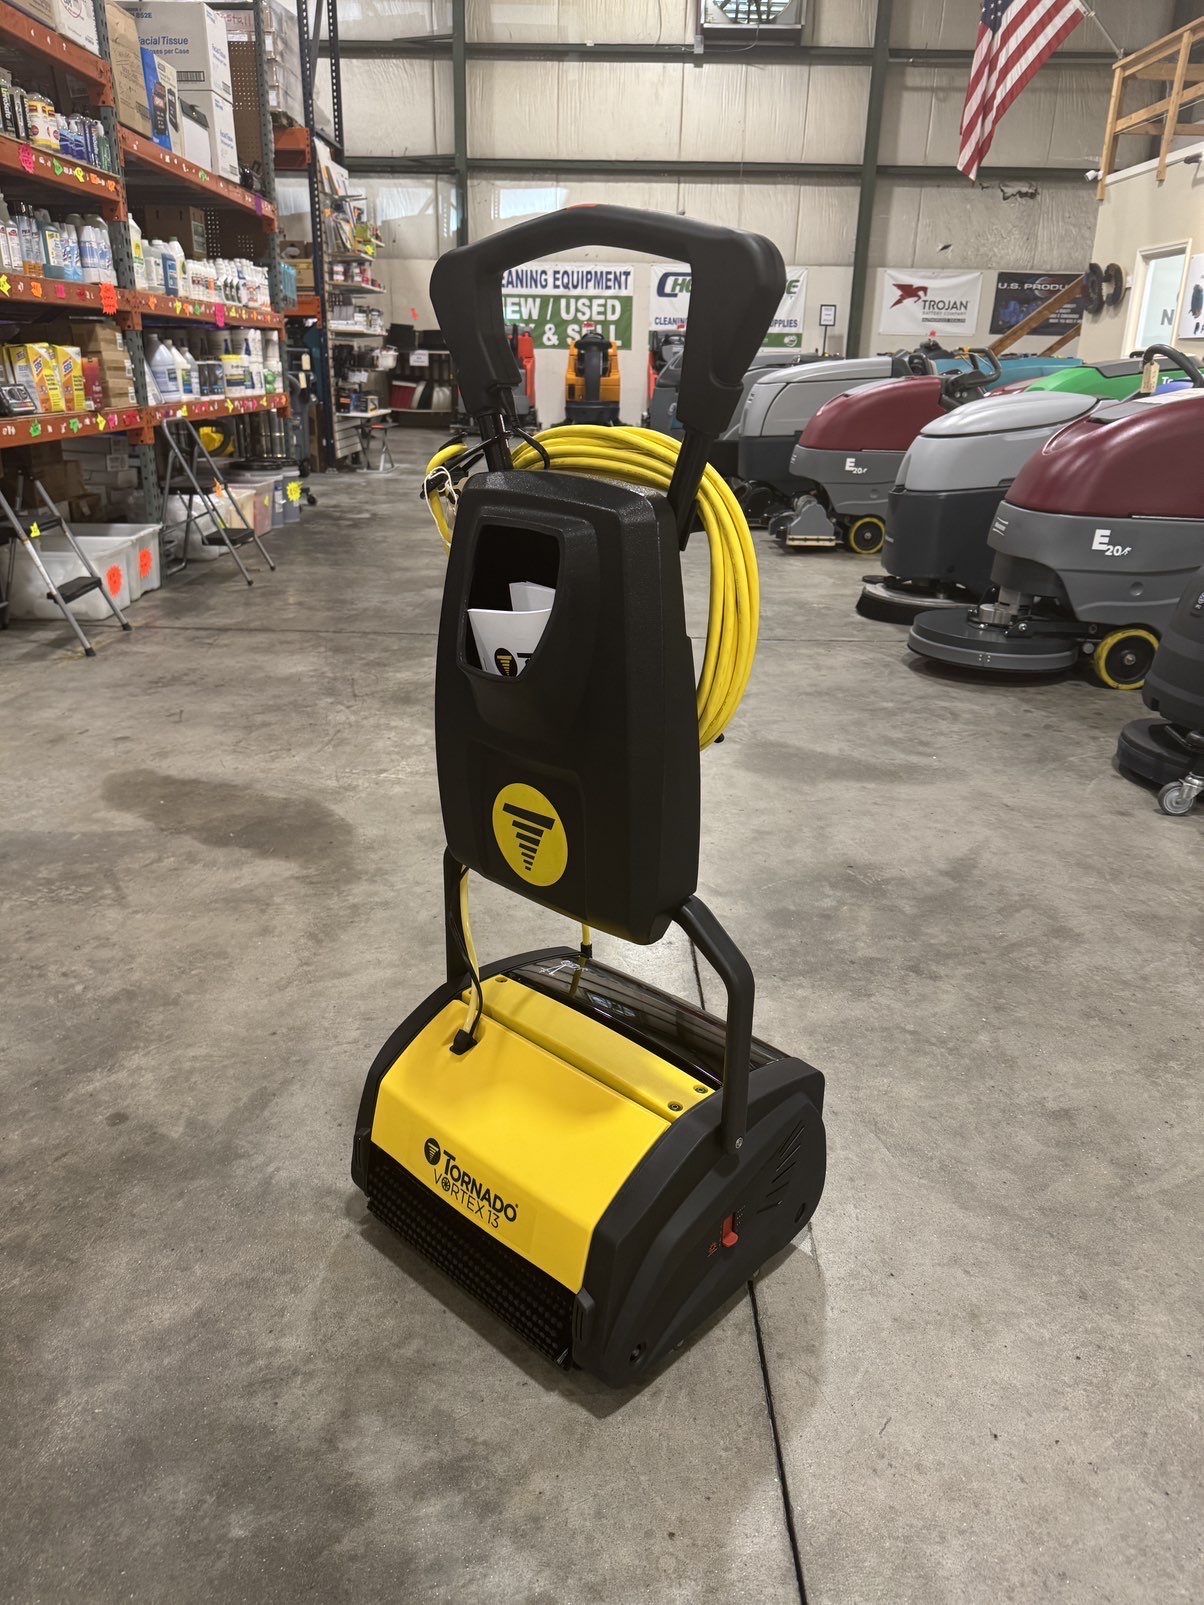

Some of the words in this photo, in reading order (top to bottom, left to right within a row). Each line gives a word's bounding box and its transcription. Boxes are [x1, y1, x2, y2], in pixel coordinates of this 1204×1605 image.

[162, 36, 189, 46] Tissue
[174, 47, 190, 55] Case
[553, 270, 631, 291] EQUIPMENT
[998, 282, 1021, 290] U.S.
[560, 298, 621, 321] USED
[922, 299, 969, 311] TROJAN
[542, 323, 559, 346] &
[433, 1168, 484, 1219] VORTEX
[487, 1209, 500, 1229] 13
